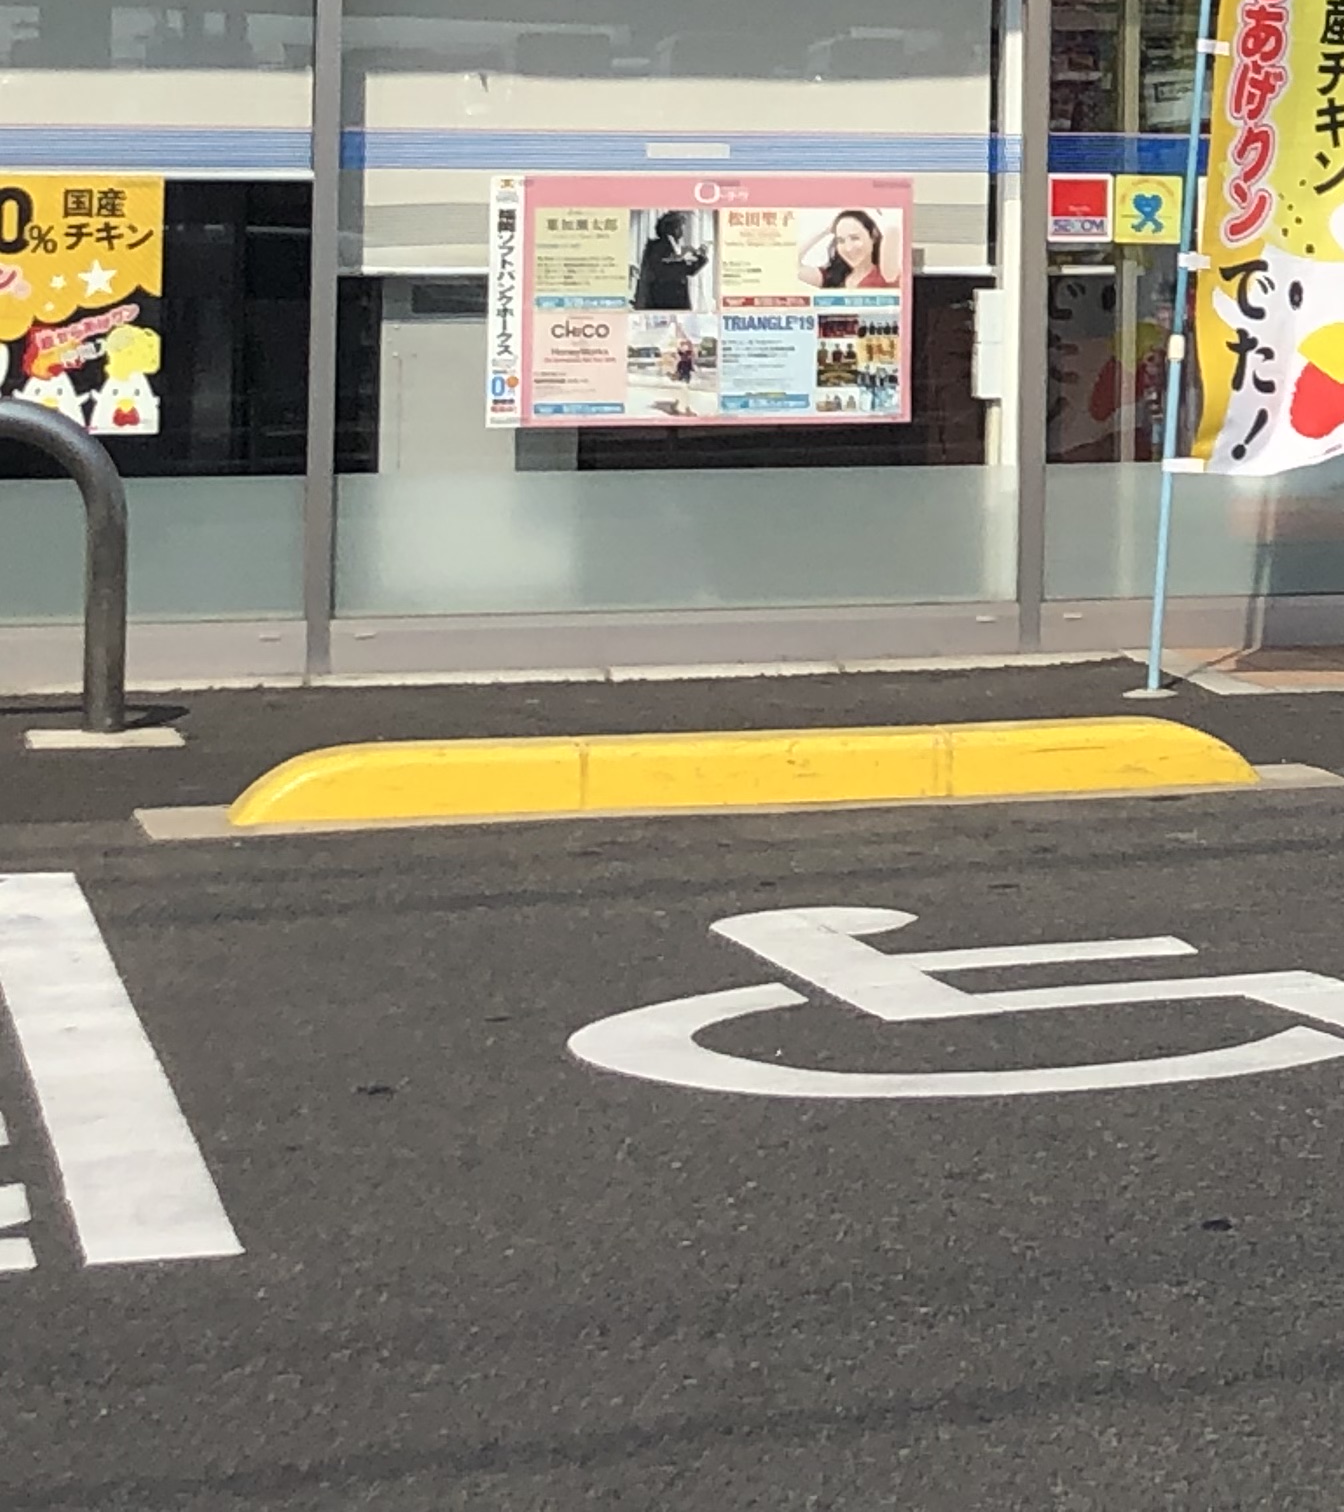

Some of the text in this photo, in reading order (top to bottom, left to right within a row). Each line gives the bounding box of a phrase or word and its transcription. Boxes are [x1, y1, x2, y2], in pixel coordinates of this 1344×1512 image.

[61, 188, 127, 219] 国産
[63, 221, 154, 251] チキン
[1221, 261, 1279, 458] でた!
